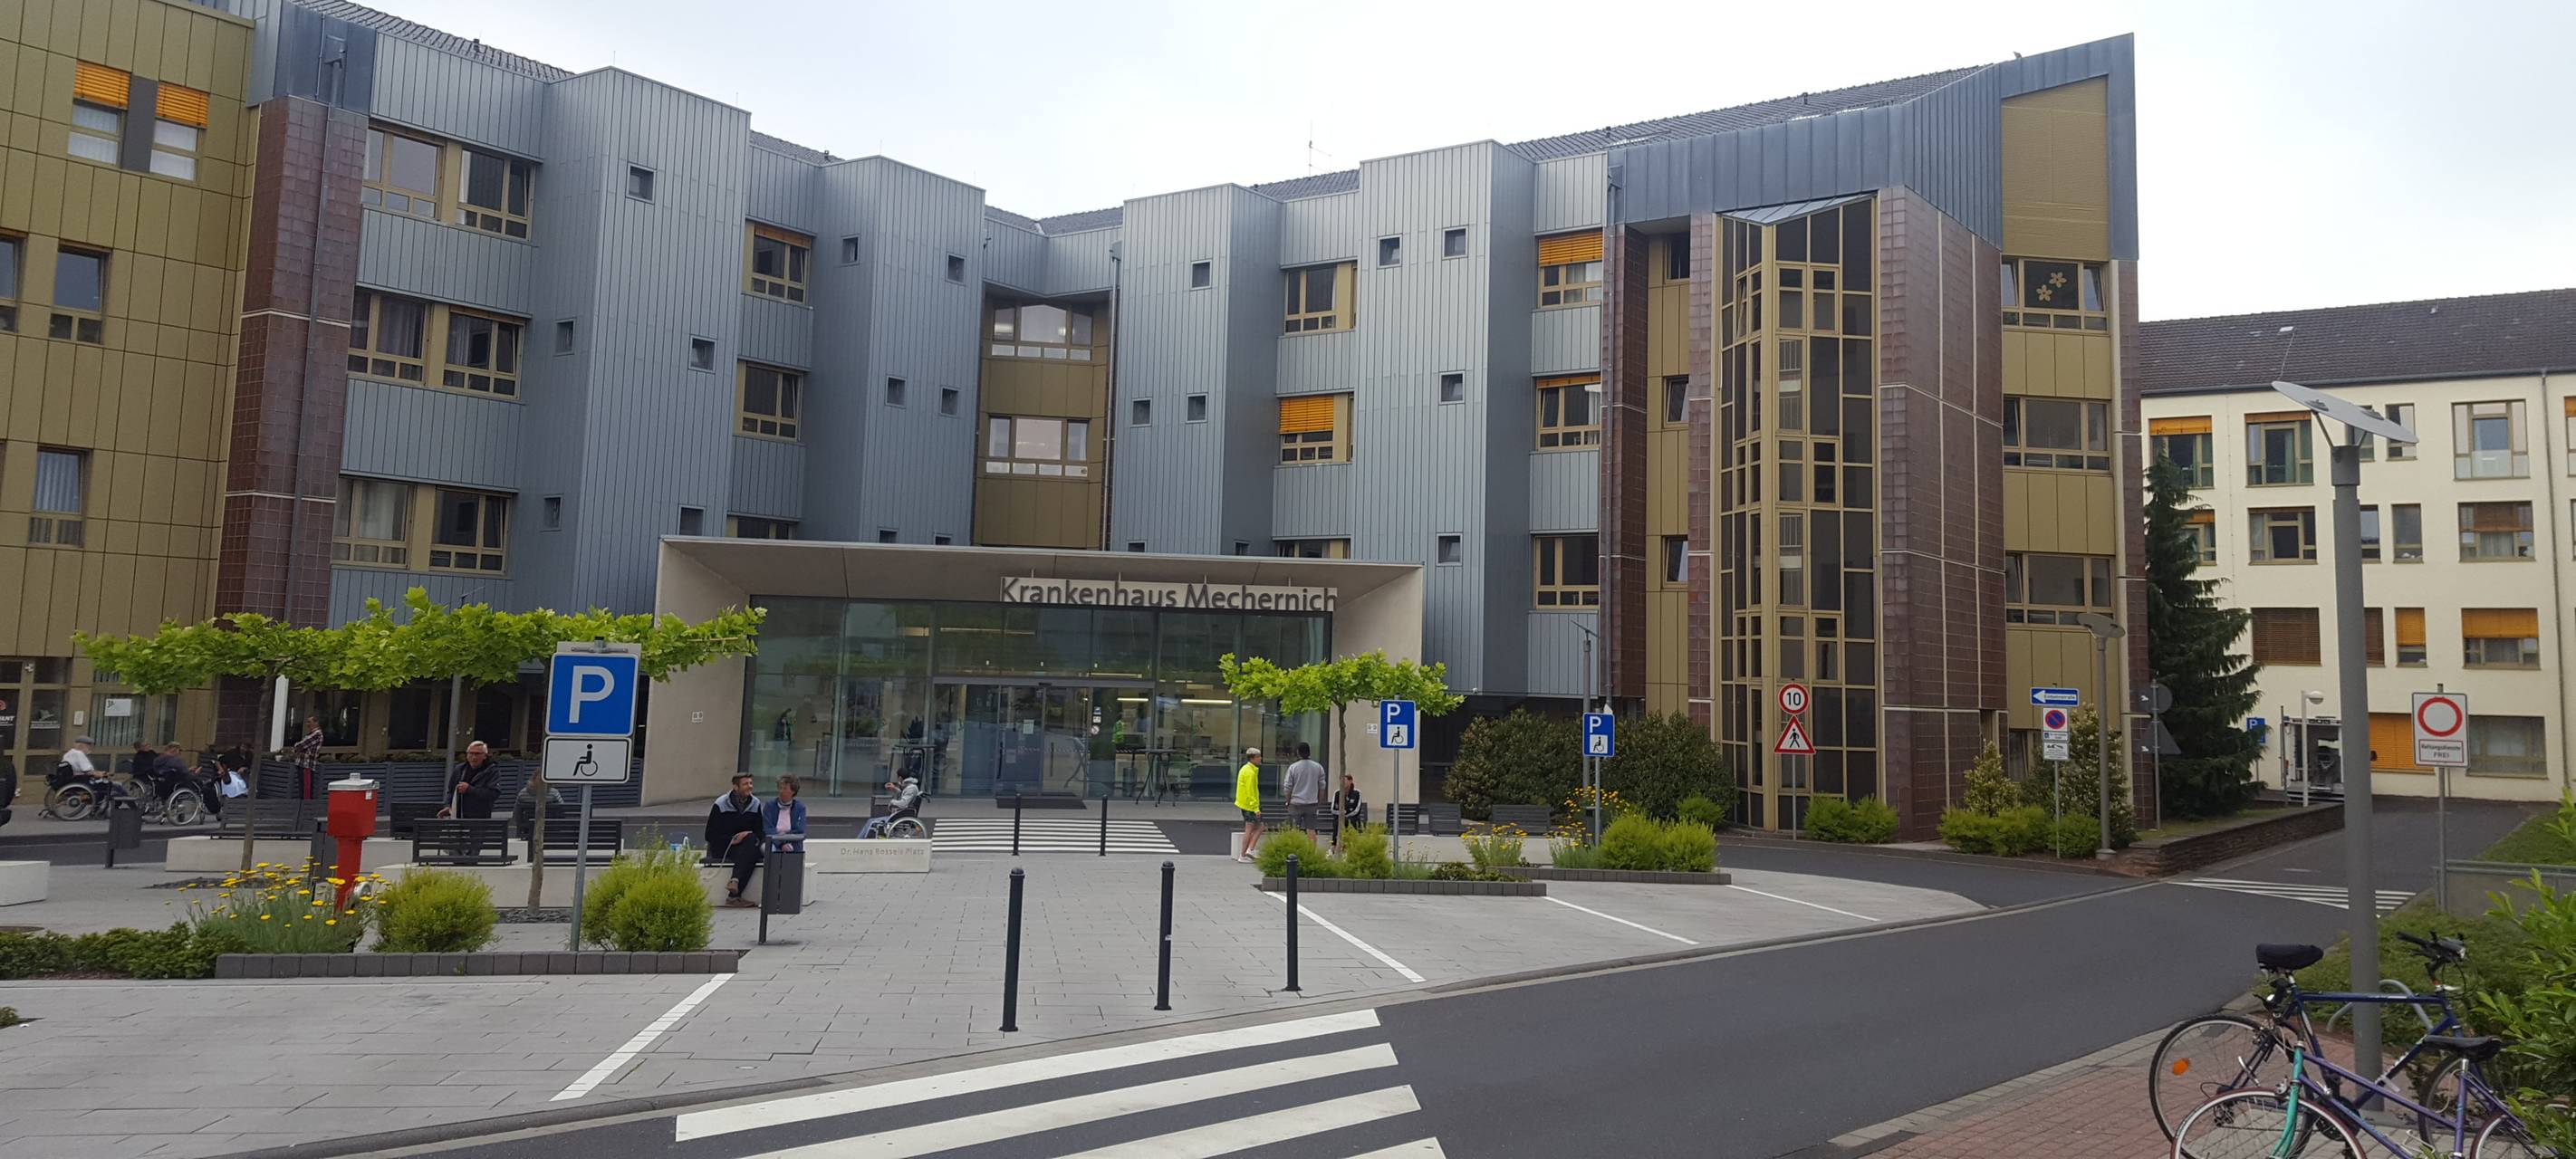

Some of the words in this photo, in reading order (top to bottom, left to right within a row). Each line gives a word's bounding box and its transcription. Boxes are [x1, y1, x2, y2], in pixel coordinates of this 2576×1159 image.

[1001, 577, 1177, 608] Krankenhaus
[1185, 583, 1337, 612] Mechernich
[569, 666, 615, 723] P
[1786, 692, 1802, 706] 10
[1387, 703, 1401, 723] P
[1589, 715, 1602, 733] P
[2249, 719, 2258, 730] P
[2433, 751, 2450, 759] FREI
